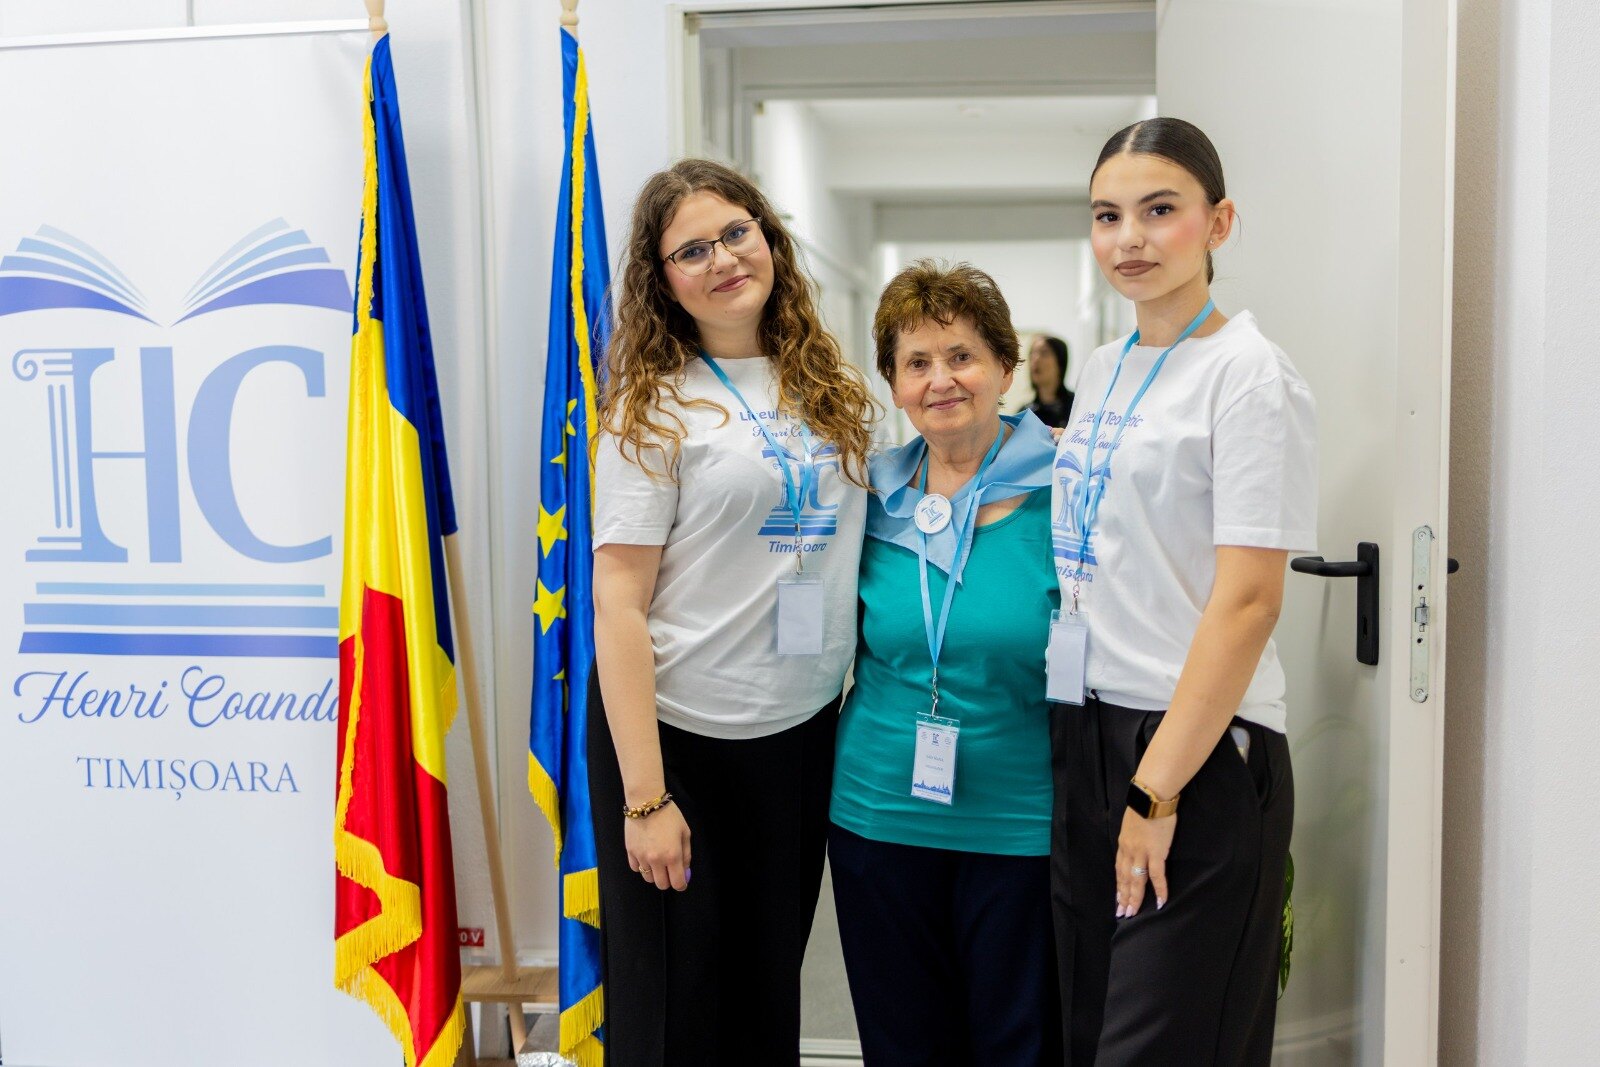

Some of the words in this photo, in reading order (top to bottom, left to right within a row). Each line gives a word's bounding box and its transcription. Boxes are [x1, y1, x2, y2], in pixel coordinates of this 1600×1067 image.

[739, 408, 779, 421] Lieul
[1078, 410, 1107, 424] Licel
[1105, 411, 1144, 428] Teoetic
[769, 540, 828, 553] Timioara
[13, 670, 169, 724] Henri
[76, 756, 301, 801] TIMIȘOARA
[471, 931, 481, 943] V
